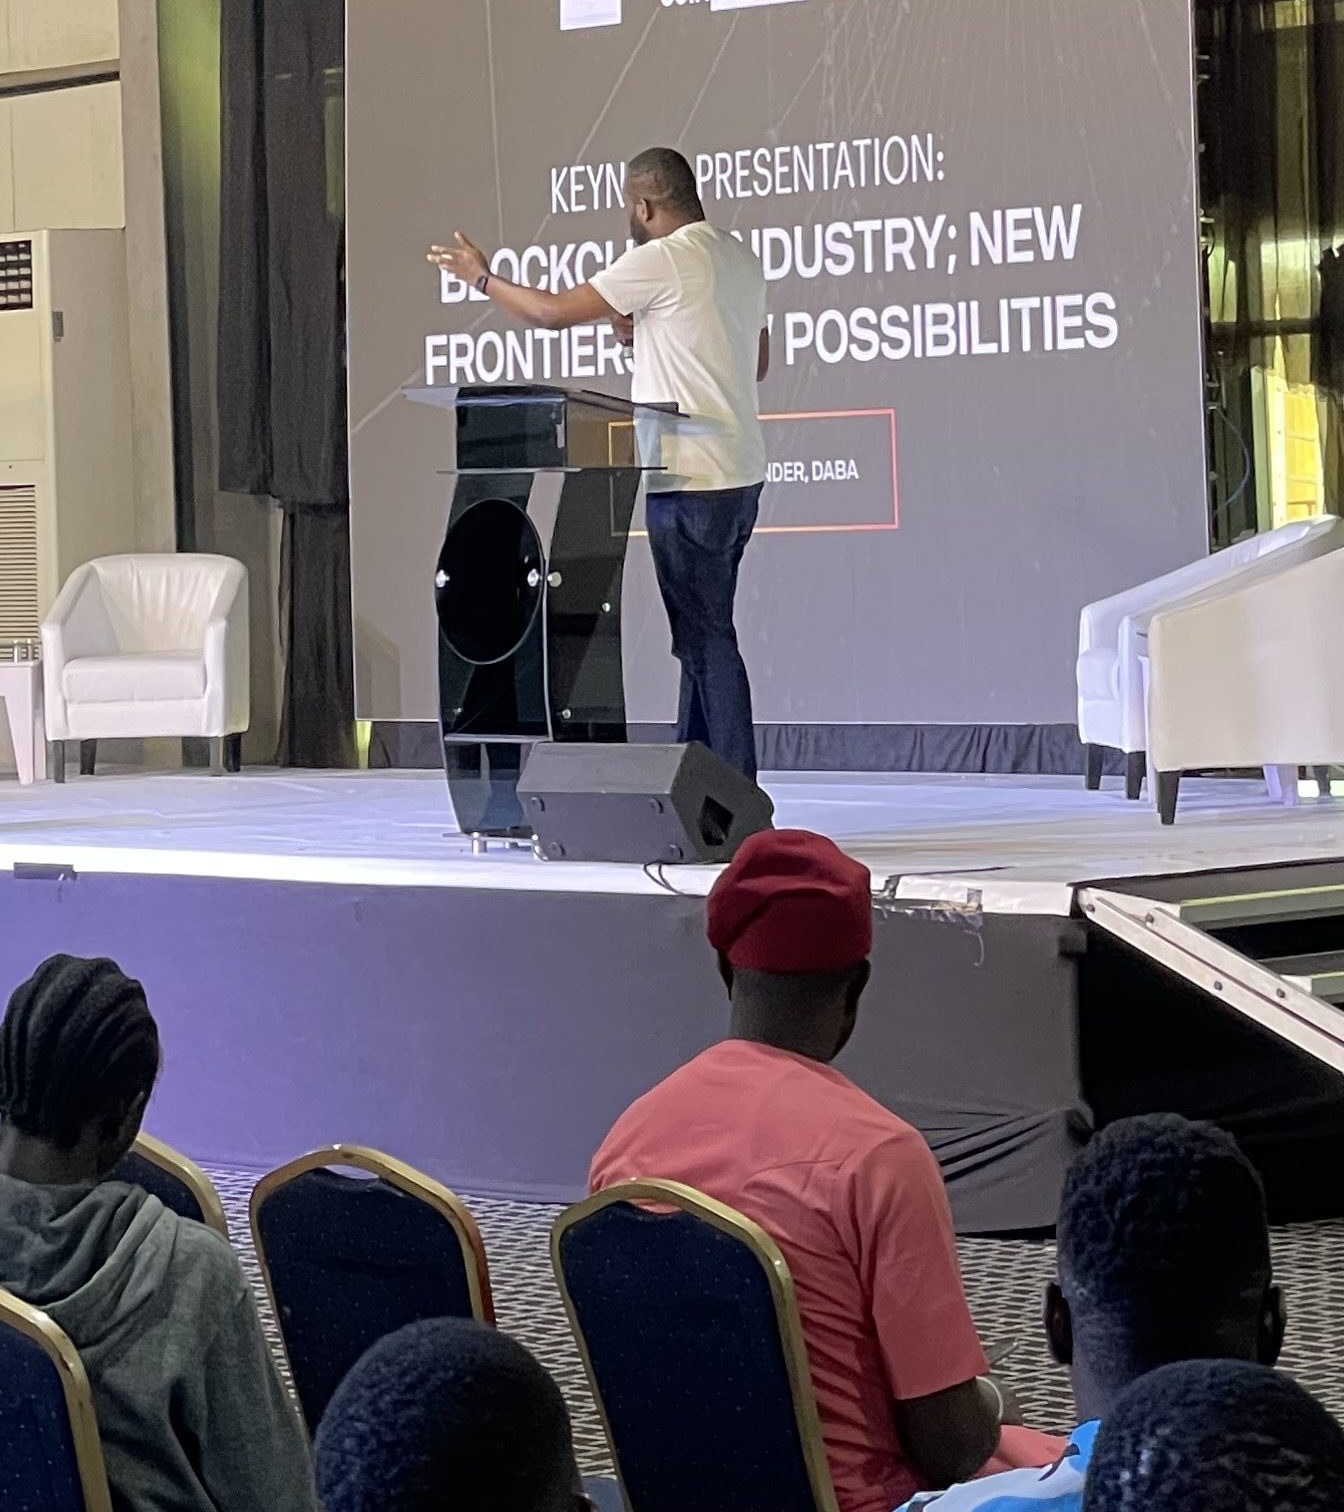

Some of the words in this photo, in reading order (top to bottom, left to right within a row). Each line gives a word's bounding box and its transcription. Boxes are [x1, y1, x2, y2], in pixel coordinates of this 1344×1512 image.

[550, 161, 626, 214] KEYN
[695, 132, 945, 202] PRESENTATION:
[730, 214, 957, 281] DUSTRY;
[969, 203, 1083, 267] NEW
[424, 323, 635, 386] FRONTIER
[784, 291, 1119, 366] POSSIBILITIES
[811, 458, 860, 481] DABA
